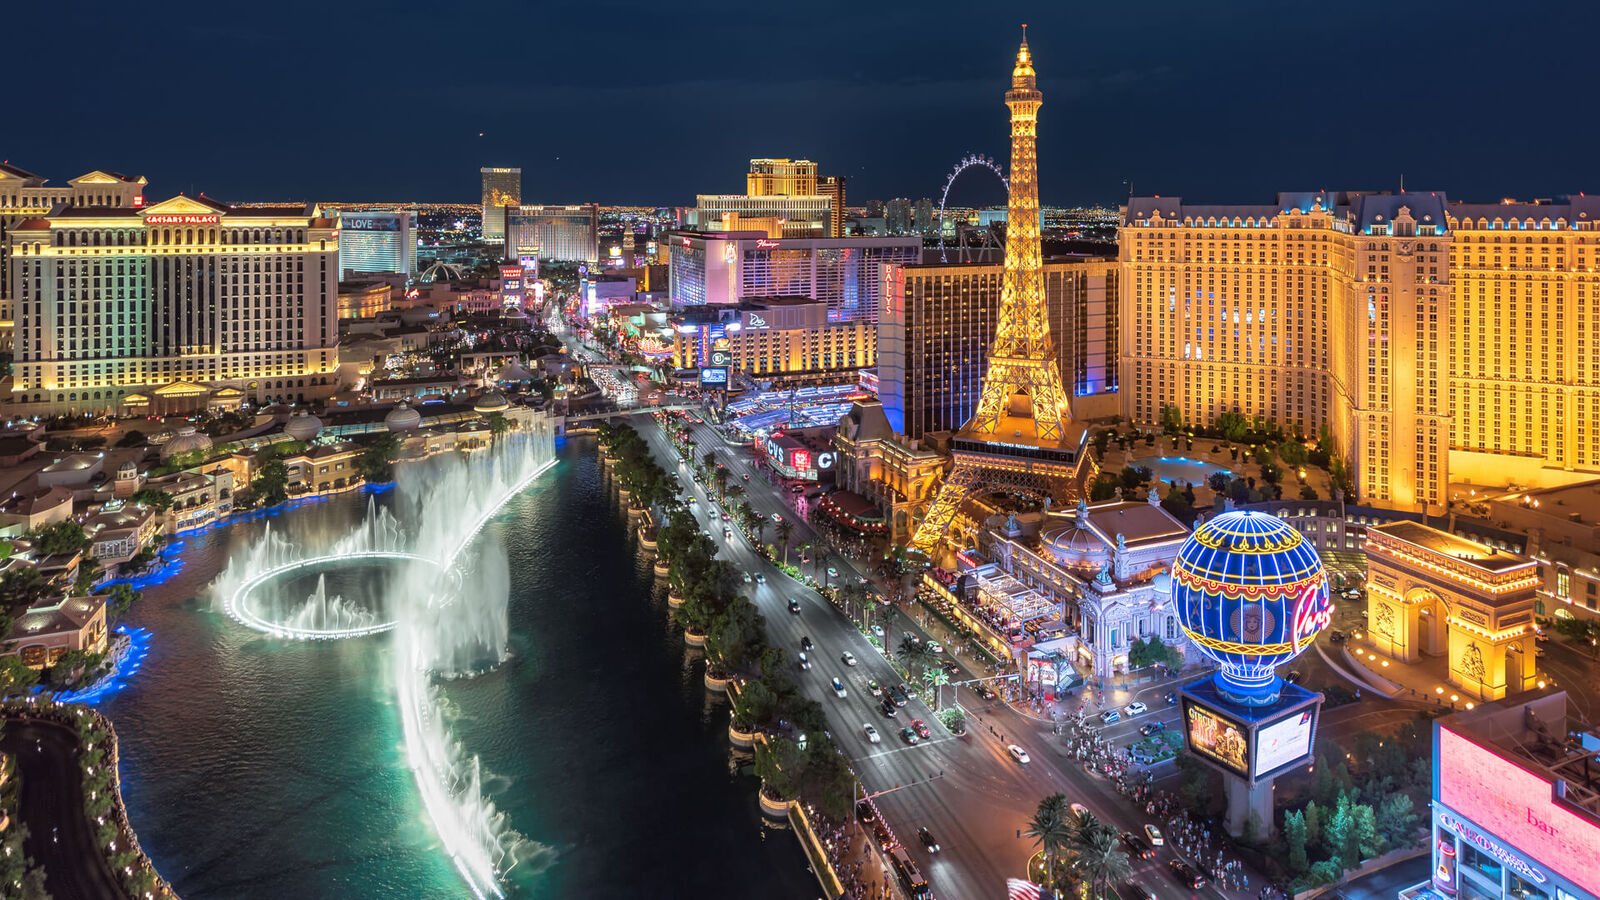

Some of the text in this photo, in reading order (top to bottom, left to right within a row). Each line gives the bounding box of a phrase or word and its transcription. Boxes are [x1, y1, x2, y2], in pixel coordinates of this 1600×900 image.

[351, 219, 373, 228] LOVE
[767, 439, 784, 463] CVS
[1293, 583, 1335, 655] Paris
[1527, 807, 1560, 836] bar
